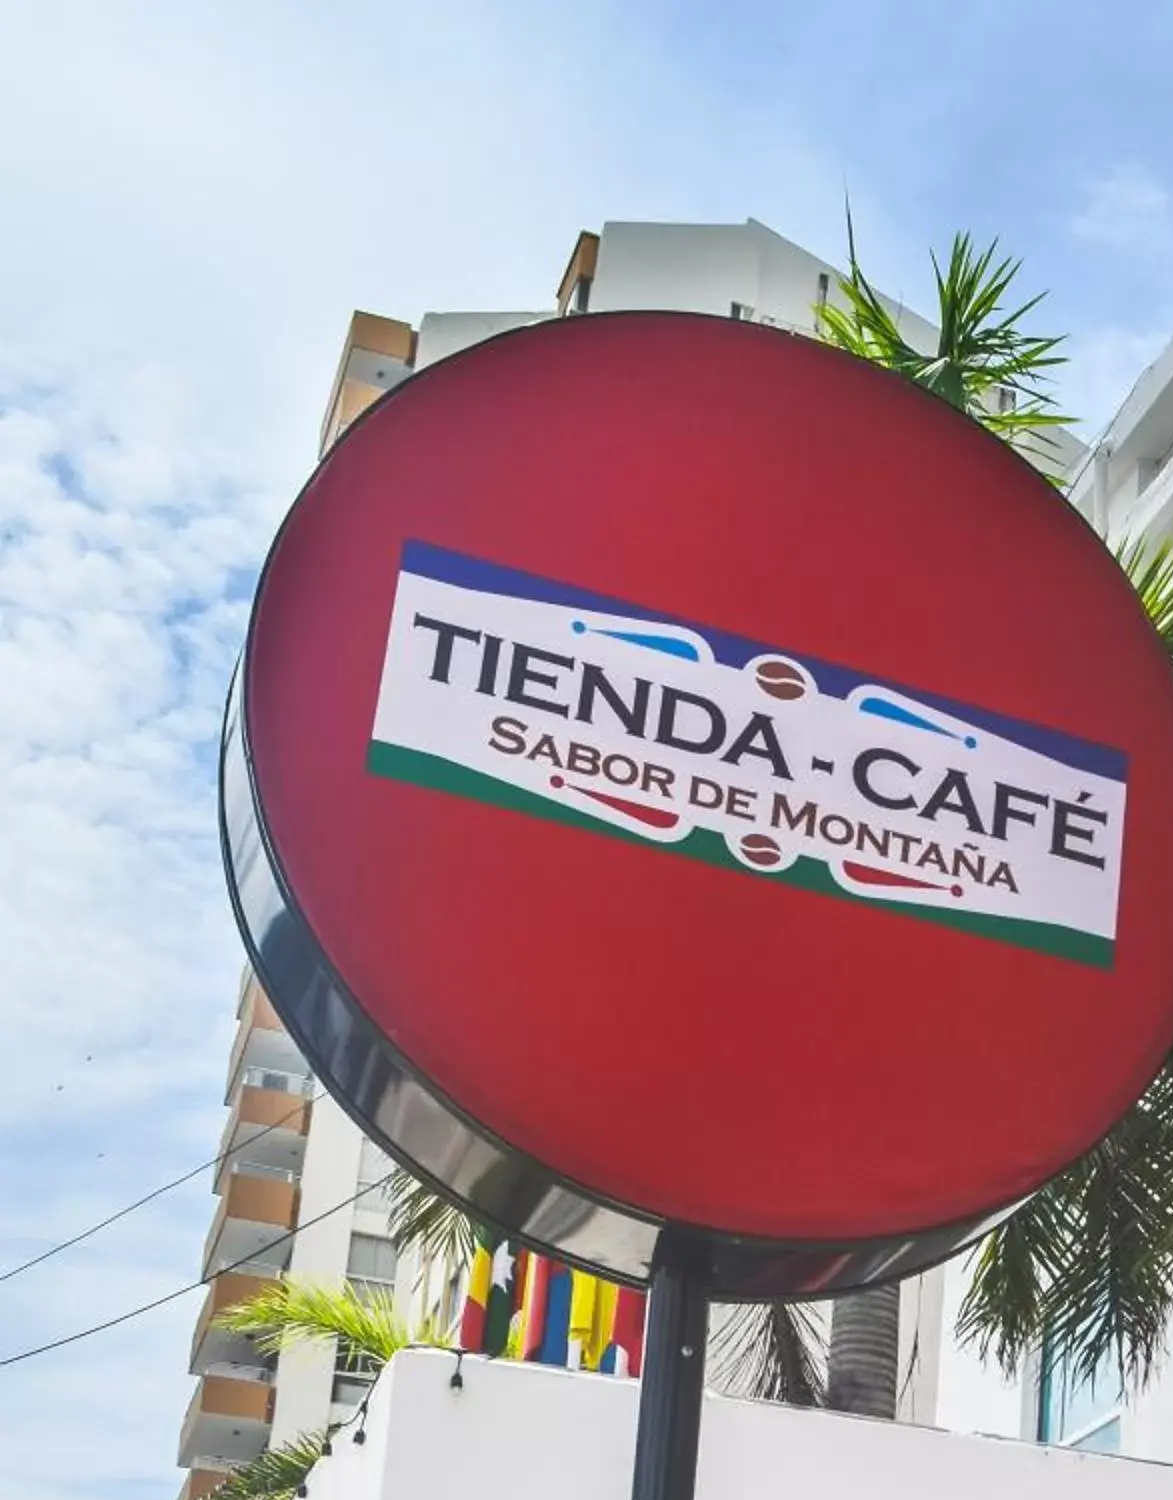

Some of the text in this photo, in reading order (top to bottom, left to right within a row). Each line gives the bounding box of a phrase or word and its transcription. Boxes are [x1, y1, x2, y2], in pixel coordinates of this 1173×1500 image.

[413, 611, 795, 781] TIENDA
[852, 747, 1108, 872] CAFÉ
[487, 715, 1021, 896] SABOR DE MONTAÑA
